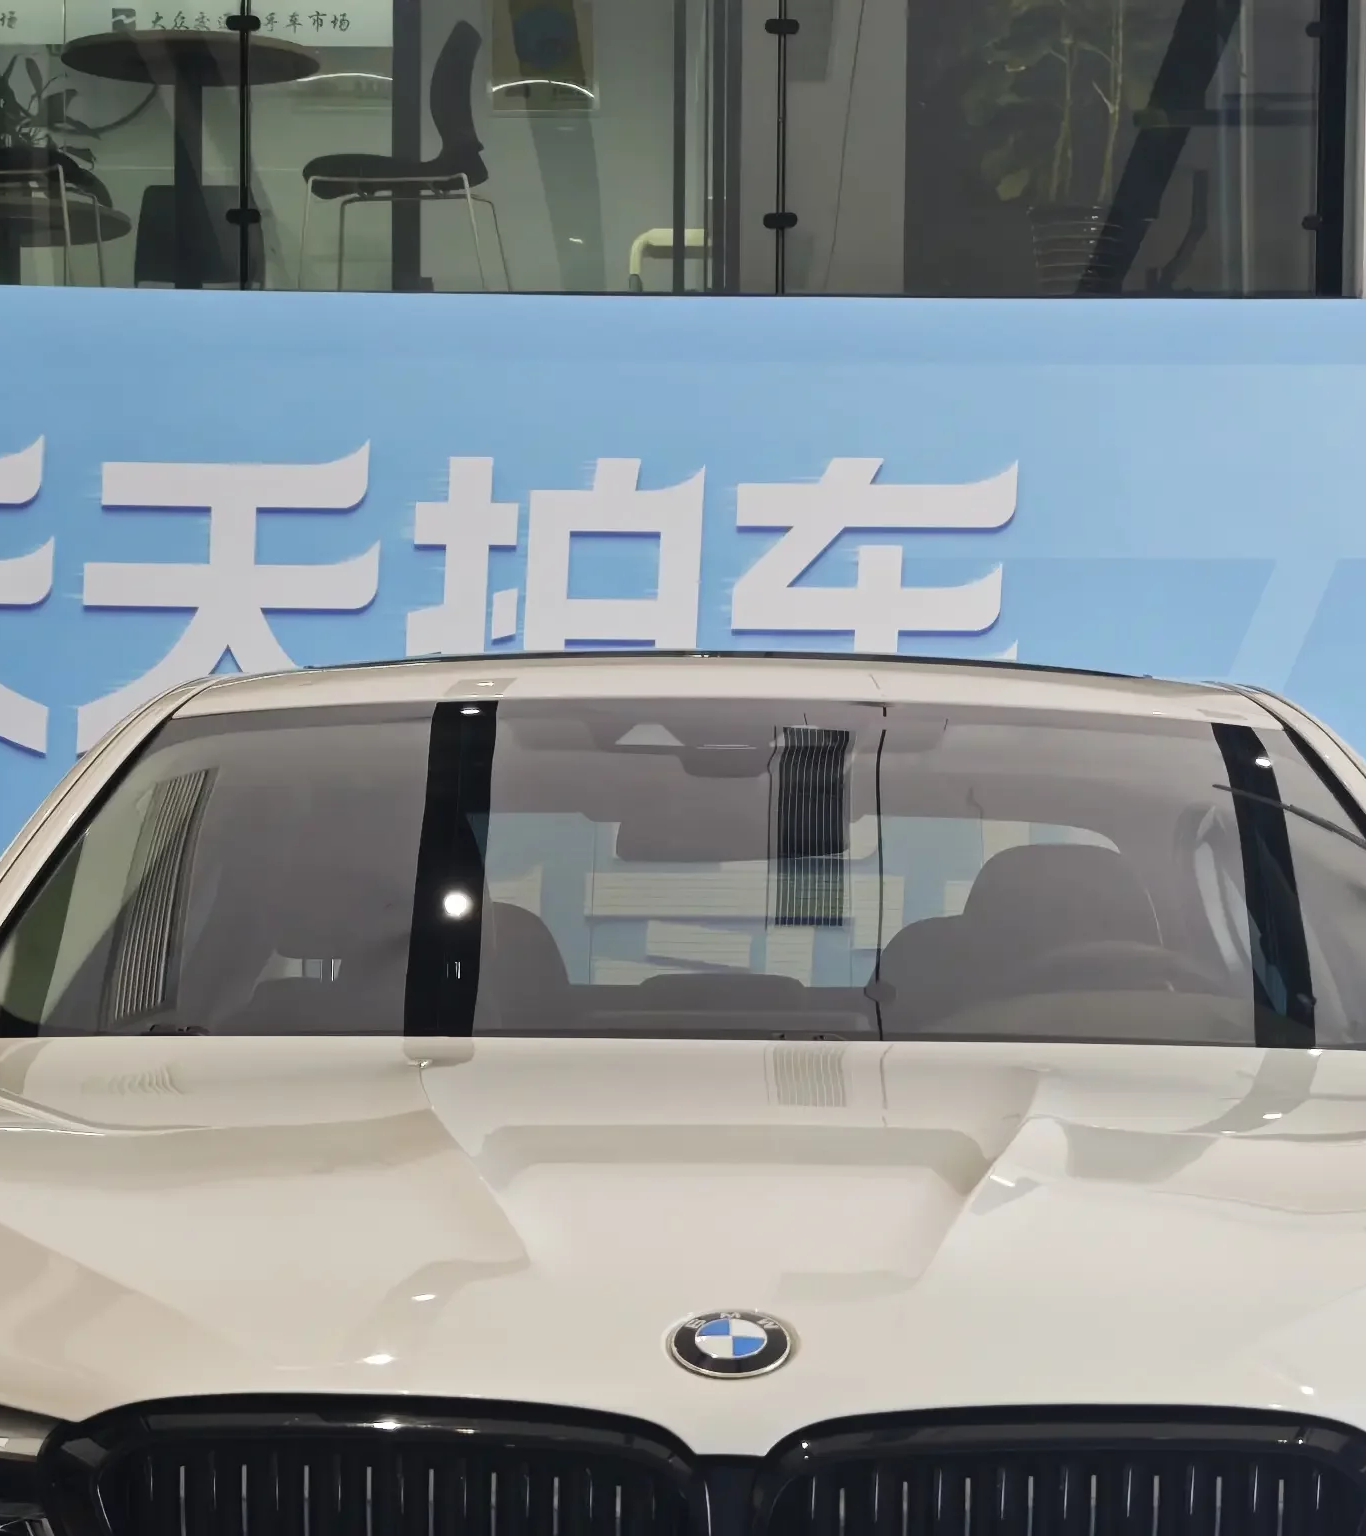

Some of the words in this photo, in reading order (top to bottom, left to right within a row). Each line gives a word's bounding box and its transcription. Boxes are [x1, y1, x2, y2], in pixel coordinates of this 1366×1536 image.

[151, 10, 350, 33] 大众交手车市场
[684, 1311, 780, 1330] BMW
